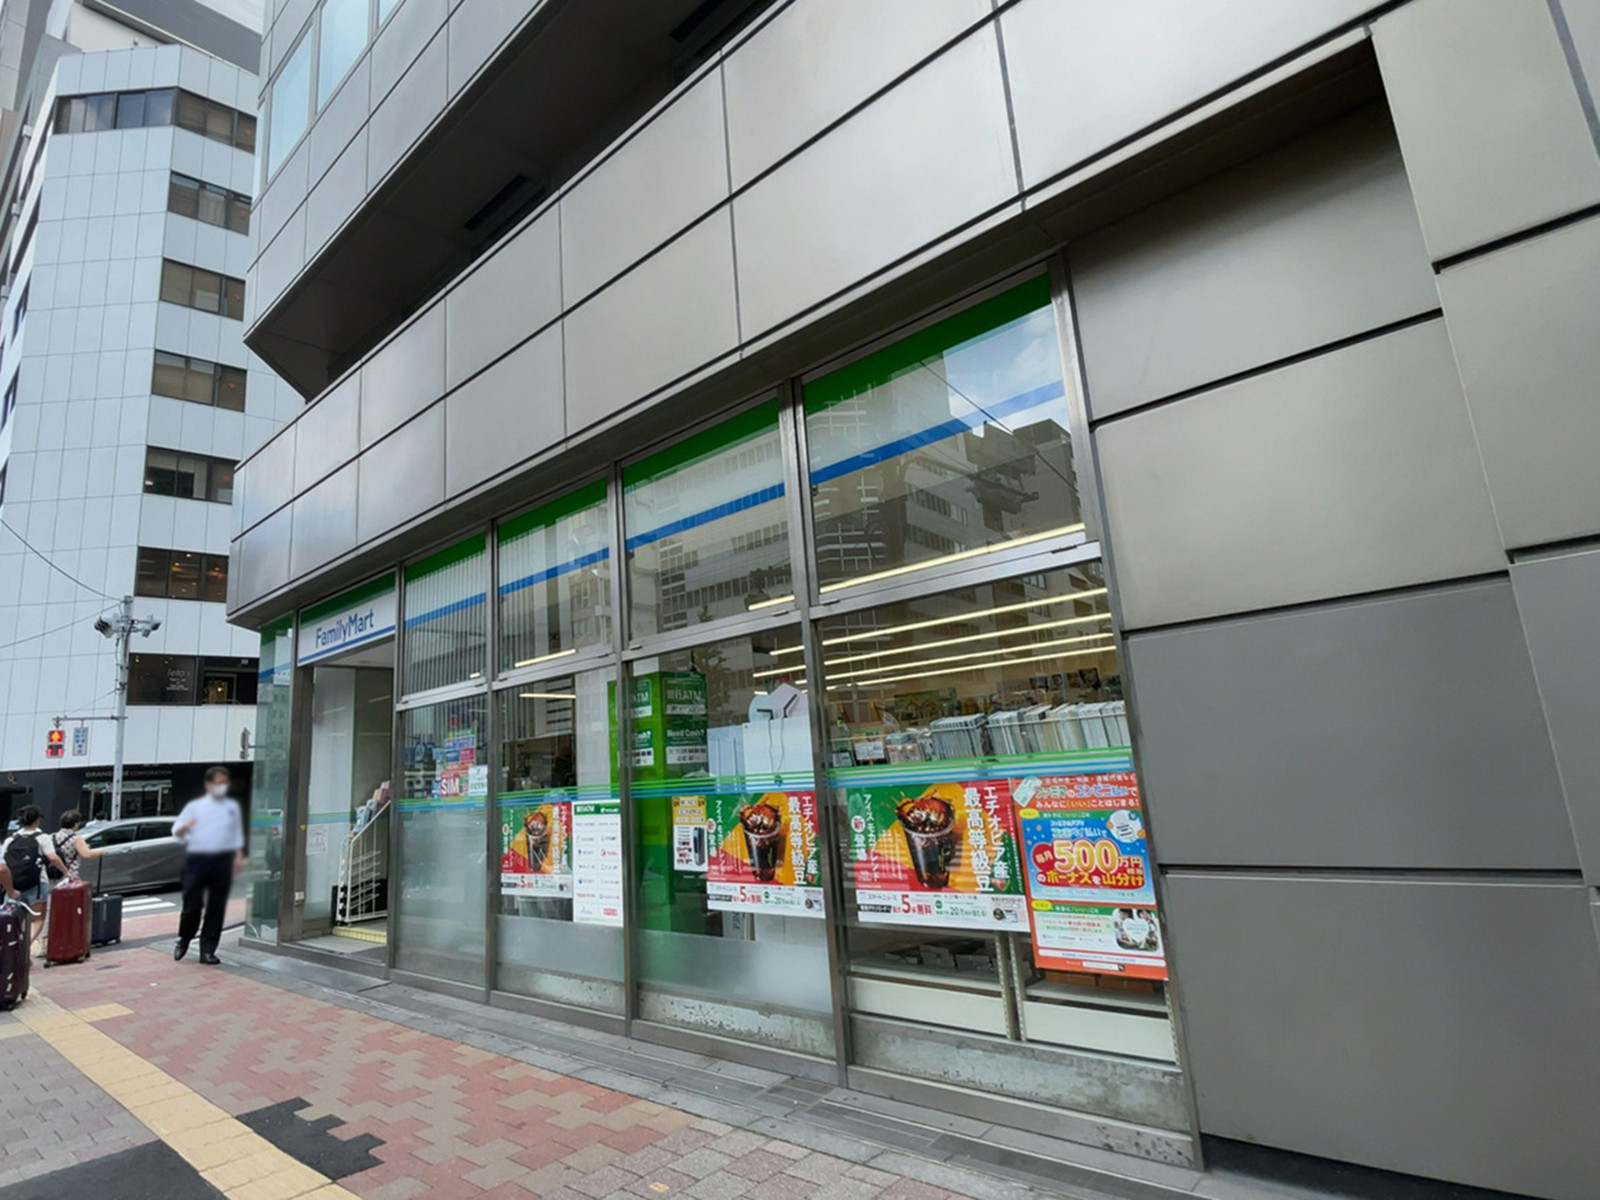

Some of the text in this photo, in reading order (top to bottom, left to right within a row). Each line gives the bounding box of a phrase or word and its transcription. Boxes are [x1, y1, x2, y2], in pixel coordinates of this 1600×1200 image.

[315, 608, 374, 648] FamilyMart
[441, 778, 459, 794] SIM
[964, 787, 995, 893] 最高等級豆
[983, 786, 1010, 880] エチオピア産
